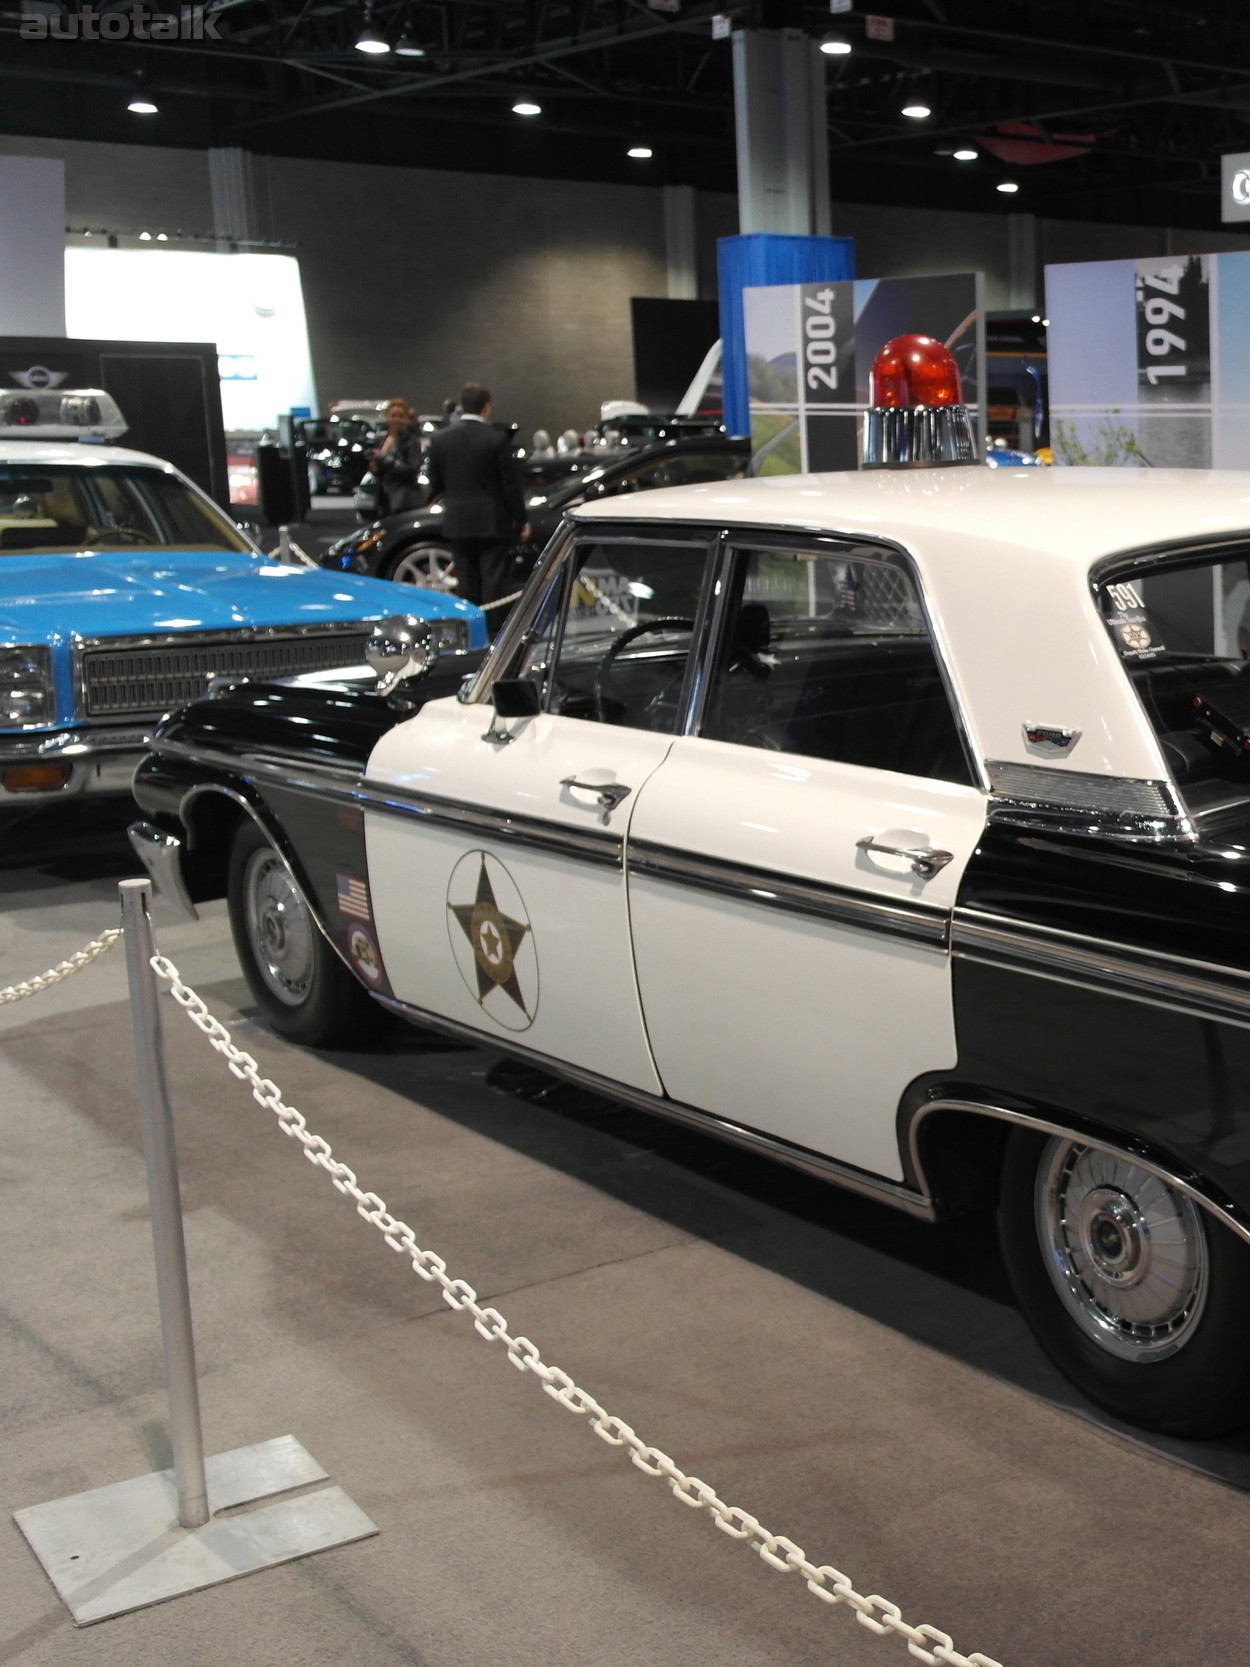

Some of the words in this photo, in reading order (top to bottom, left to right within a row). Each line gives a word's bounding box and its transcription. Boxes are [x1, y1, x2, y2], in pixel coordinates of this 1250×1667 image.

[805, 288, 838, 390] 2004
[1144, 264, 1187, 385] 1994
[1106, 583, 1145, 610] 591
